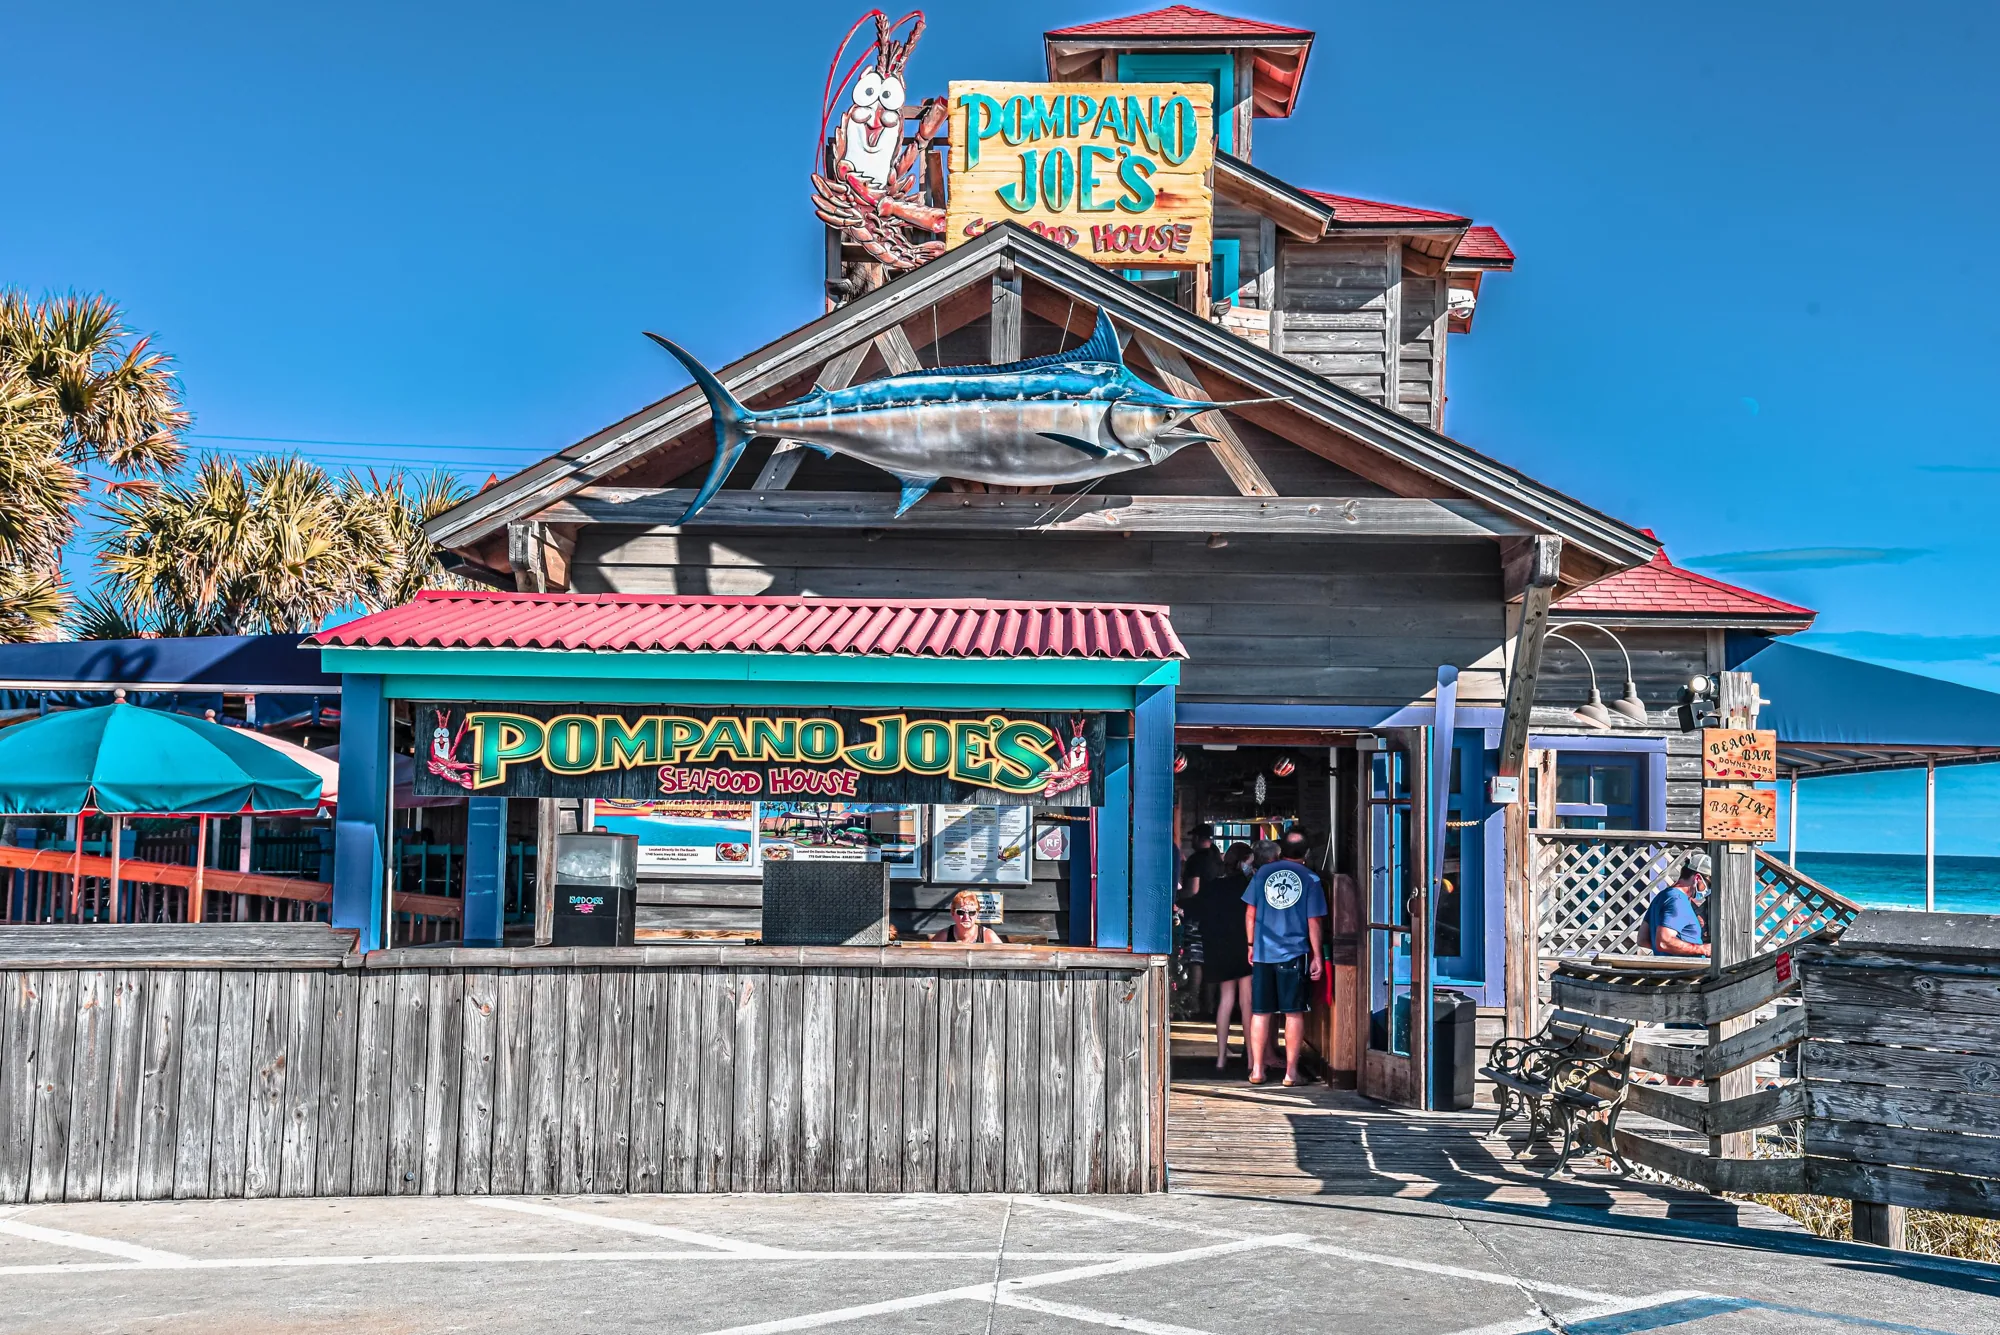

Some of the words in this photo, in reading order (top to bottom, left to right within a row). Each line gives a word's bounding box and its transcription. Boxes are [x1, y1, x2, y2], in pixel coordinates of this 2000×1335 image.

[957, 92, 1198, 172] POMPANO
[995, 145, 1158, 213] JOE'S
[1090, 223, 1192, 254] HOUSE
[466, 712, 844, 790] POMPANO
[845, 713, 1058, 794] JOE'S
[1710, 732, 1757, 755] BEACH
[1741, 748, 1772, 761] BAR
[1719, 756, 1773, 775] DOWNSTAIRS
[658, 765, 763, 795] SEAFOOD
[769, 766, 861, 797] HOUSE
[1709, 800, 1740, 816] BAR
[1736, 792, 1773, 819] TIKI
[1046, 838, 1060, 847] RF
[1267, 872, 1288, 888] CAPTAIN
